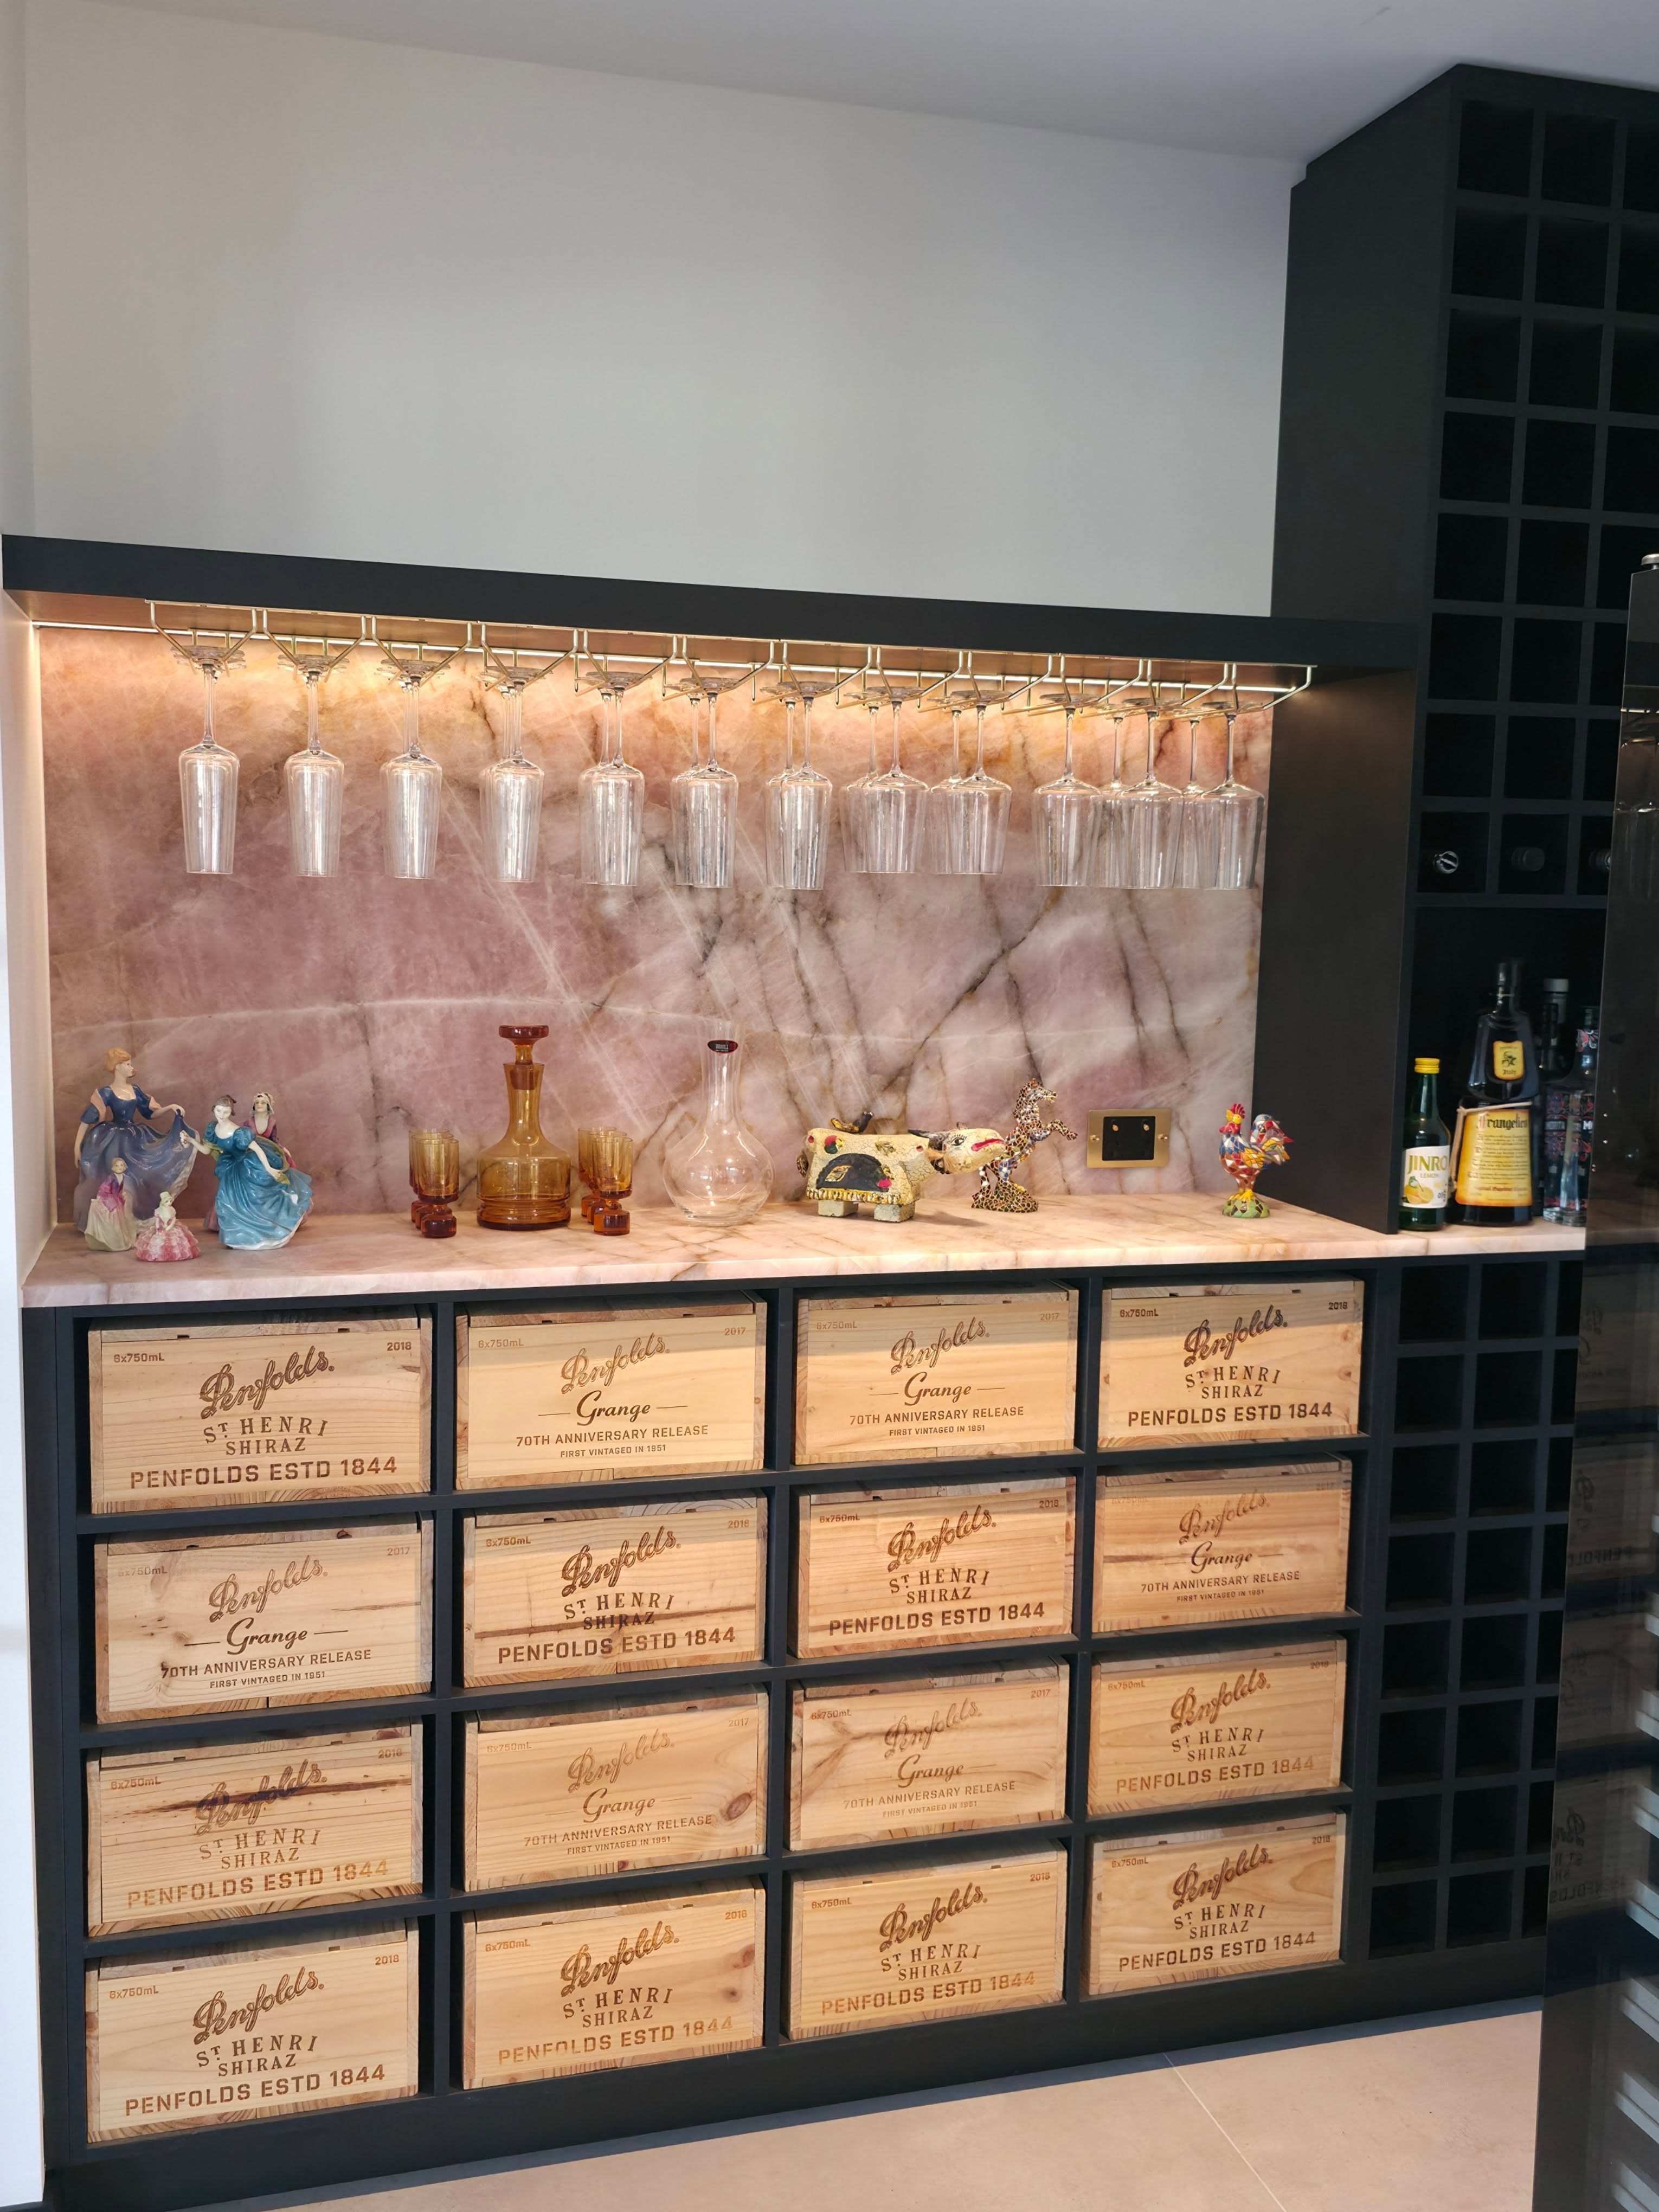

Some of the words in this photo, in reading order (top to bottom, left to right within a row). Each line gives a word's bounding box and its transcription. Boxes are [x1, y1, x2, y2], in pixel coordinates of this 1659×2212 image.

[1407, 1155, 1449, 1174] JINRO
[1039, 1312, 1059, 1321] 2017
[724, 1327, 746, 1336] 2017
[387, 1341, 412, 1353] 2018
[478, 1338, 524, 1349] 6x750mL
[113, 1352, 165, 1364] 6x750mL
[1213, 1365, 1281, 1384] HENRI
[904, 1371, 972, 1406] Grange
[1201, 1384, 1263, 1399] SHIRAZ
[576, 1390, 651, 1426] Grange
[850, 1413, 880, 1426] 70TH
[885, 1409, 968, 1423] ANNIVERSARY
[973, 1406, 1024, 1419] RELEASE
[1128, 1406, 1226, 1426] PENFOLDS
[1234, 1404, 1281, 1422] ESTD
[1288, 1402, 1333, 1419] 1844
[240, 1416, 328, 1437] HENRI
[516, 1434, 550, 1448] 70TH
[555, 1429, 647, 1445] ANNIVERSARY
[652, 1425, 709, 1438] RELEASE
[889, 1428, 911, 1436] FIRST
[915, 1426, 954, 1435] VINTAGED
[967, 1424, 986, 1433] 1951
[226, 1437, 306, 1456] SHIRAZ
[560, 1449, 585, 1458] FIRST
[589, 1447, 632, 1457] VINTAGED
[635, 1446, 644, 1454] IN
[647, 1444, 666, 1453] 1951
[130, 1464, 259, 1489] PENFOLDS
[271, 1460, 330, 1481] ESTD
[340, 1456, 397, 1476] 1844
[728, 1518, 750, 1530] 2018
[387, 1546, 410, 1557] 2017
[1191, 1541, 1252, 1574] Grange
[918, 1567, 990, 1586] HENRI
[1141, 1581, 1169, 1593] 70TH
[1173, 1575, 1249, 1591] ANNIVERSARY
[1253, 1571, 1300, 1584] RELEASE
[596, 1591, 674, 1611] HENRI
[906, 1586, 972, 1604] SHIRAZ
[583, 1611, 655, 1631] SHIRAZ
[829, 1611, 933, 1636] PENFOLDS
[942, 1606, 991, 1626] ESTD
[998, 1602, 1045, 1621] 1844
[227, 1617, 308, 1655] Grange
[498, 1637, 613, 1664] PENFOLDS
[623, 1632, 676, 1653] ESTD
[684, 1626, 736, 1647] 1844
[161, 1664, 199, 1680] 70TH
[204, 1655, 304, 1675] ANNIVERSARY
[310, 1649, 371, 1665] RELEASE
[210, 1679, 237, 1689] FIRST
[241, 1675, 288, 1686] VINTAGED
[292, 1674, 301, 1682] IN
[304, 1671, 326, 1681] 1951
[1031, 1688, 1051, 1698] 2017
[728, 1718, 749, 1728] 2017
[1199, 1727, 1264, 1745] HENRI
[1187, 1744, 1248, 1763] SHIRAZ
[897, 1753, 964, 1788] Grange
[1116, 1767, 1212, 1793] PENFOLDS
[1220, 1761, 1264, 1782] ESTD
[1271, 1756, 1314, 1774] 1844
[583, 1787, 655, 1823] Grange
[844, 1797, 874, 1810] 70TH
[878, 1787, 960, 1806] ANNIVERSARY
[965, 1781, 1015, 1796] RELEASE
[883, 1809, 905, 1818] FIRST
[234, 1828, 321, 1849] HENRI
[524, 1832, 557, 1847] 70TH
[562, 1822, 652, 1842] ANNIVERSARY
[657, 1815, 712, 1831] RELEASE
[567, 1845, 591, 1855] FIRST
[595, 1840, 637, 1852] VINTAGED
[640, 1838, 649, 1847] IN
[652, 1836, 671, 1846] 1951
[221, 1847, 299, 1870] SHIRAZ
[128, 1875, 254, 1908] PENFOLDS
[265, 1867, 323, 1891] ESTD
[332, 1859, 388, 1882] 1844
[725, 1909, 748, 1922] 2018
[1201, 1902, 1266, 1921] HENRI
[1189, 1920, 1249, 1939] SHIRAZ
[375, 1954, 400, 1967] 2018
[910, 1943, 981, 1963] HENRI
[1118, 1944, 1213, 1972] PENFOLDS
[1221, 1938, 1266, 1958] ESTD
[1273, 1931, 1316, 1951] 1844
[898, 1960, 963, 1982] SHIRAZ
[595, 1987, 673, 2008] HENRI
[821, 1986, 924, 2016] PENFOLDS
[934, 1978, 981, 1999] ESTD
[989, 1971, 1035, 1991] 1844
[583, 2005, 653, 2028] SHIRAZ
[621, 2024, 674, 2048] ESTD
[683, 2016, 733, 2039] 1844
[232, 2034, 318, 2056] HENRI
[218, 2053, 297, 2077] SHIRAZ
[125, 2082, 250, 2116] PENFOLDS
[261, 2073, 320, 2097] ESTD
[329, 2064, 385, 2087] 1844
